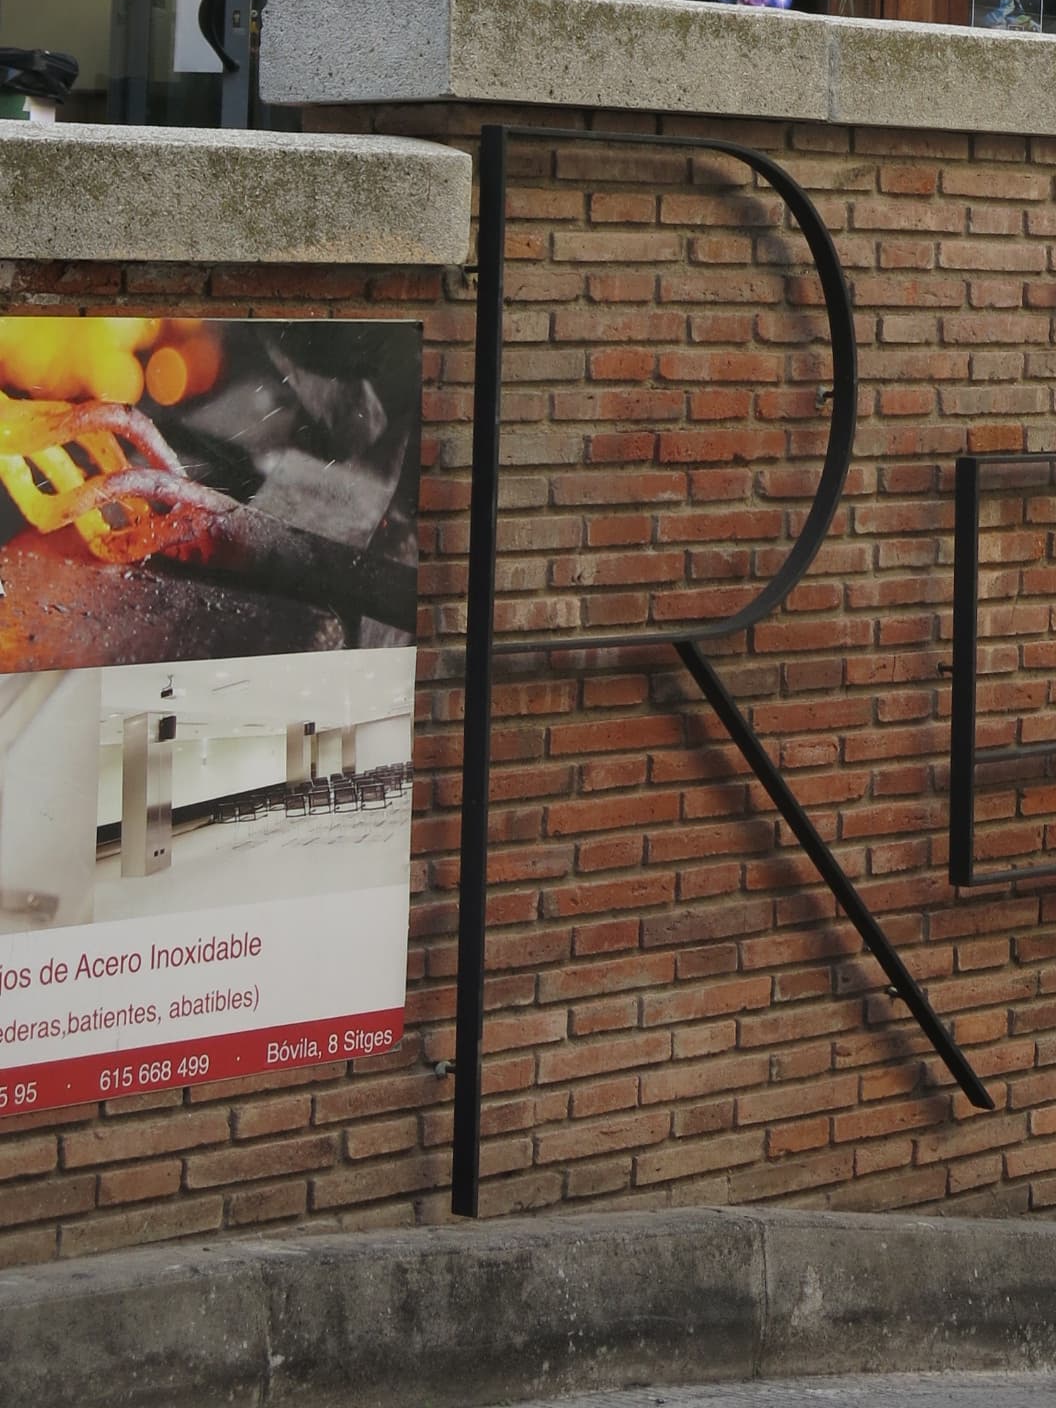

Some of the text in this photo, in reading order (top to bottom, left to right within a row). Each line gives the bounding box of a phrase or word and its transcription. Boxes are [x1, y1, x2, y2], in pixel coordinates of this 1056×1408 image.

[40, 958, 68, 986] de
[75, 952, 142, 982] Acero
[150, 932, 262, 970] Inoxidable
[169, 984, 260, 1019] abatibles)
[266, 1027, 393, 1064] Bóvila, 8 Sitges
[14, 1082, 38, 1105] 95
[100, 1066, 133, 1091] 615
[138, 1060, 172, 1085] 668
[177, 1053, 210, 1078] 499
